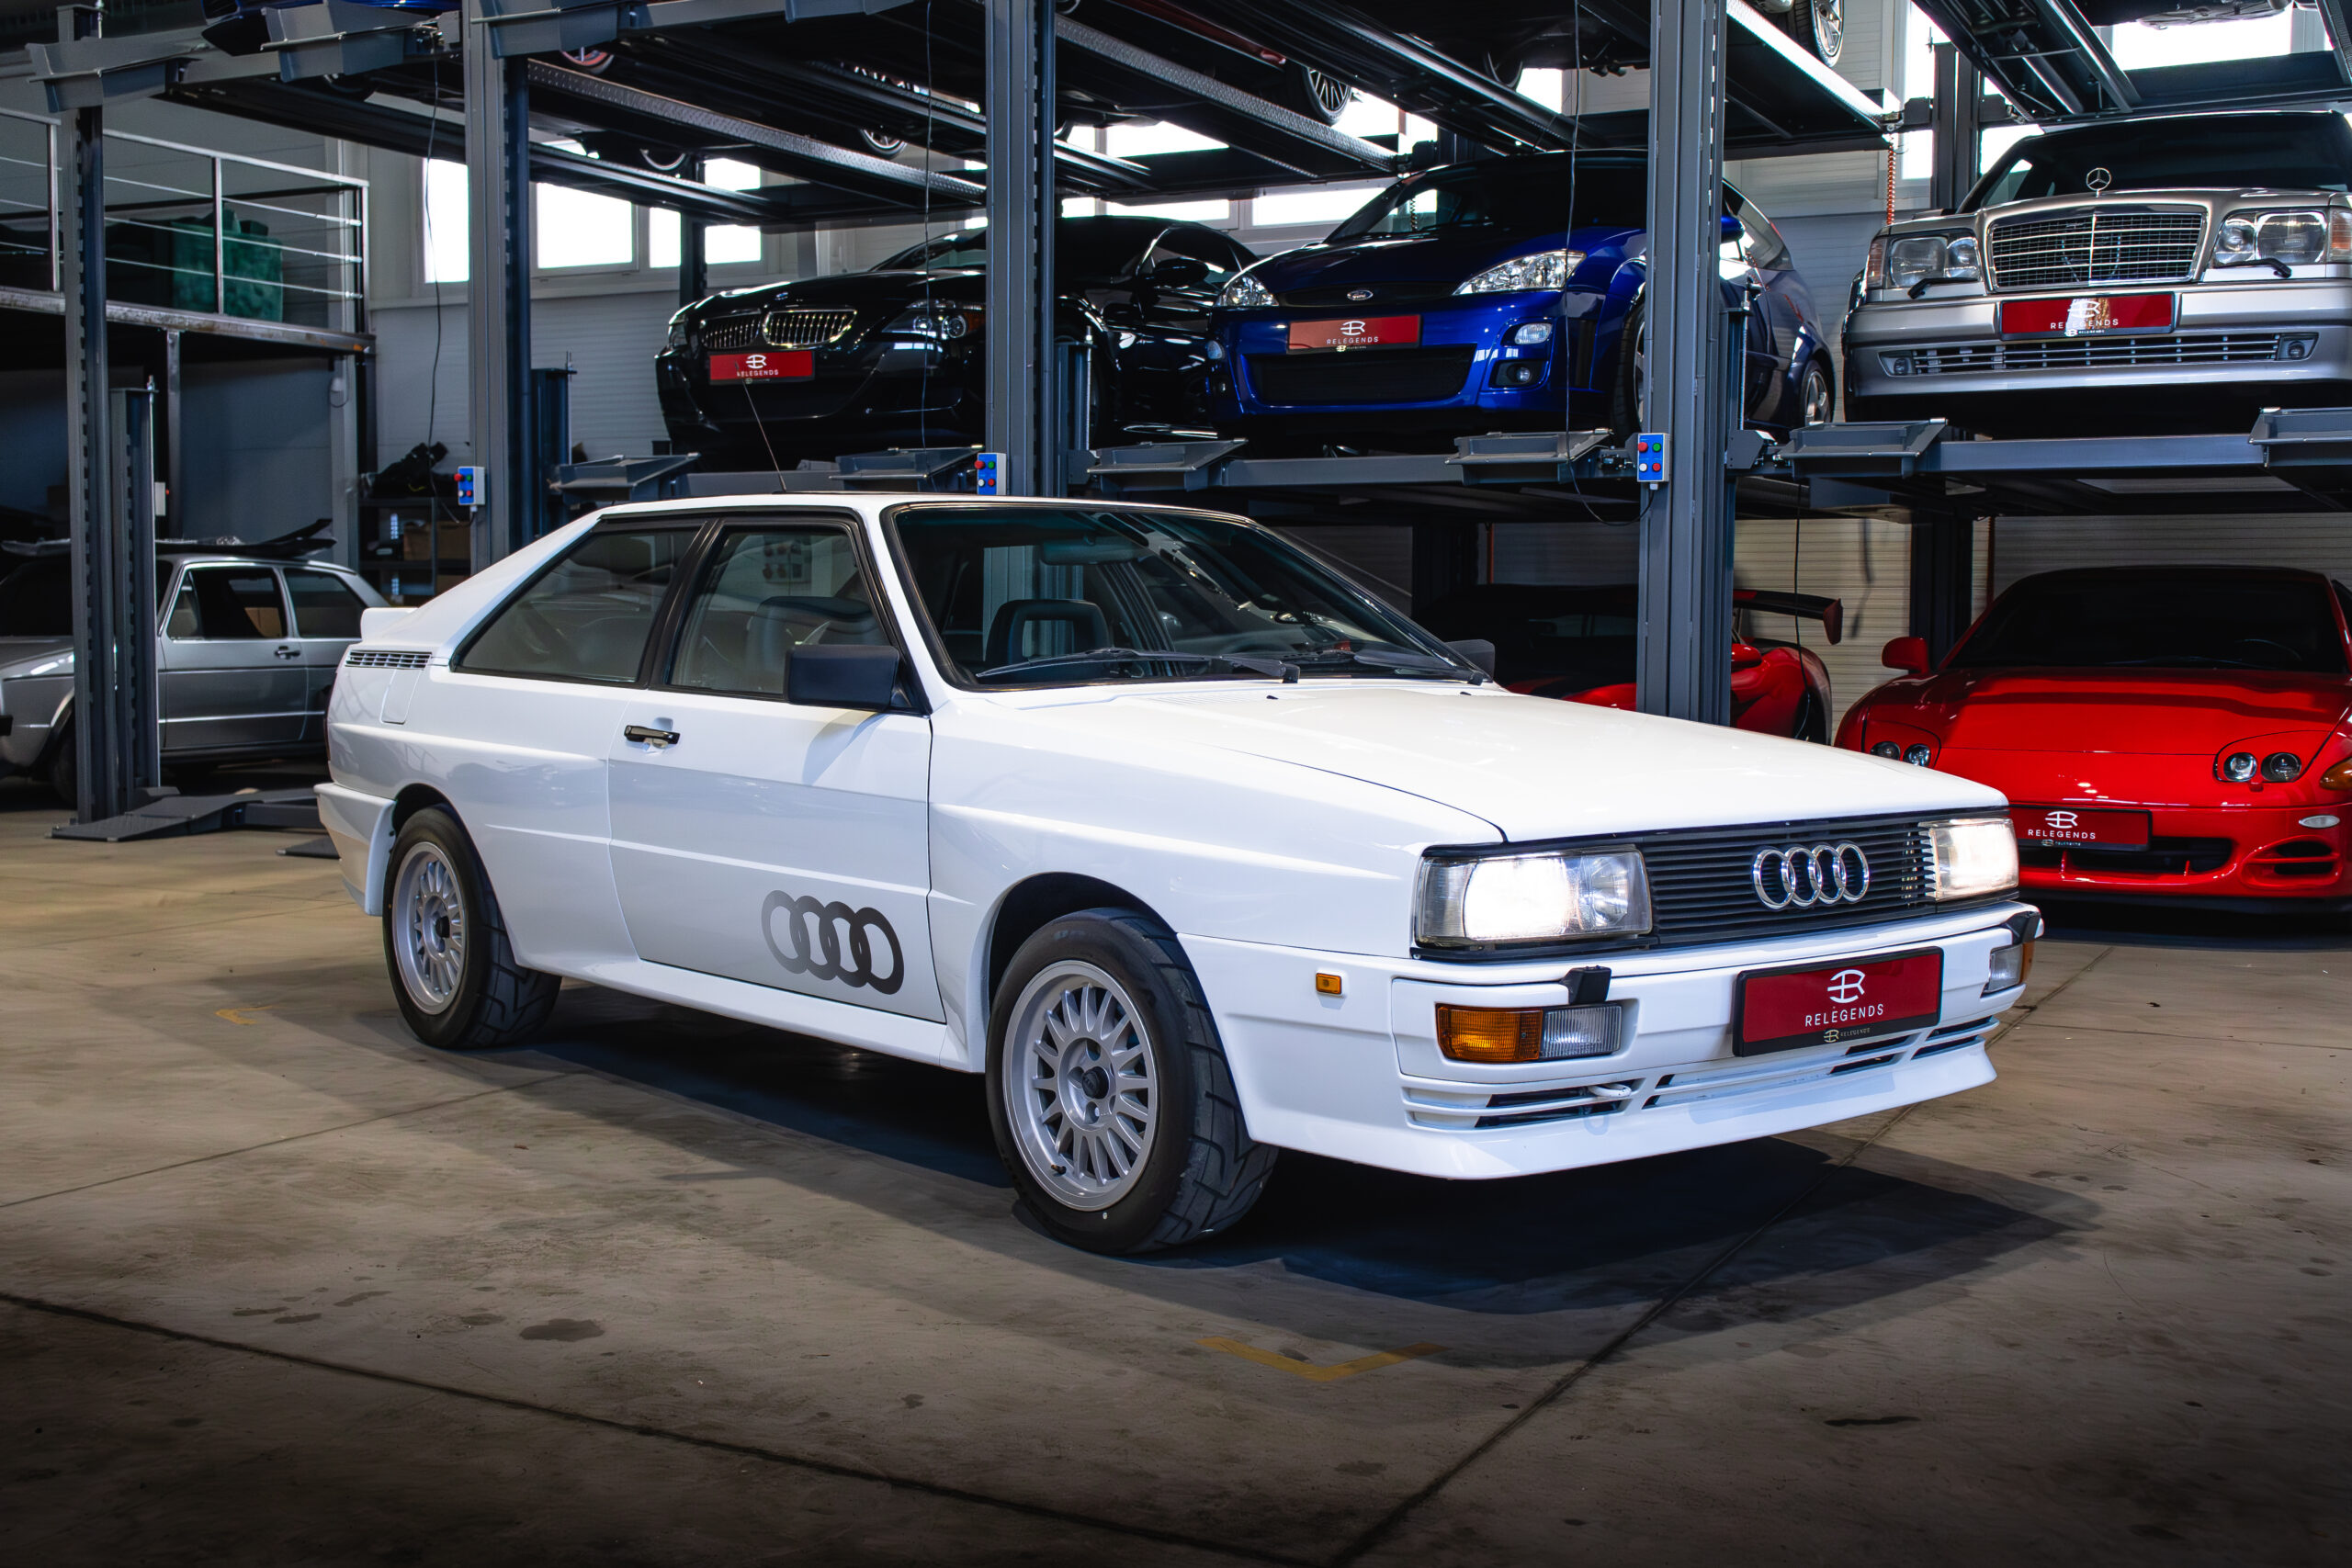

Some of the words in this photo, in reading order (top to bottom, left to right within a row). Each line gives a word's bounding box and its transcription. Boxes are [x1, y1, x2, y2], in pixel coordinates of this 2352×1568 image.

[2050, 319, 2119, 329] REEGENDS
[1326, 336, 1379, 344] RELEGENDS
[2028, 829, 2096, 840] RELEGENDS
[1805, 1003, 1883, 1027] RELEGENDS
